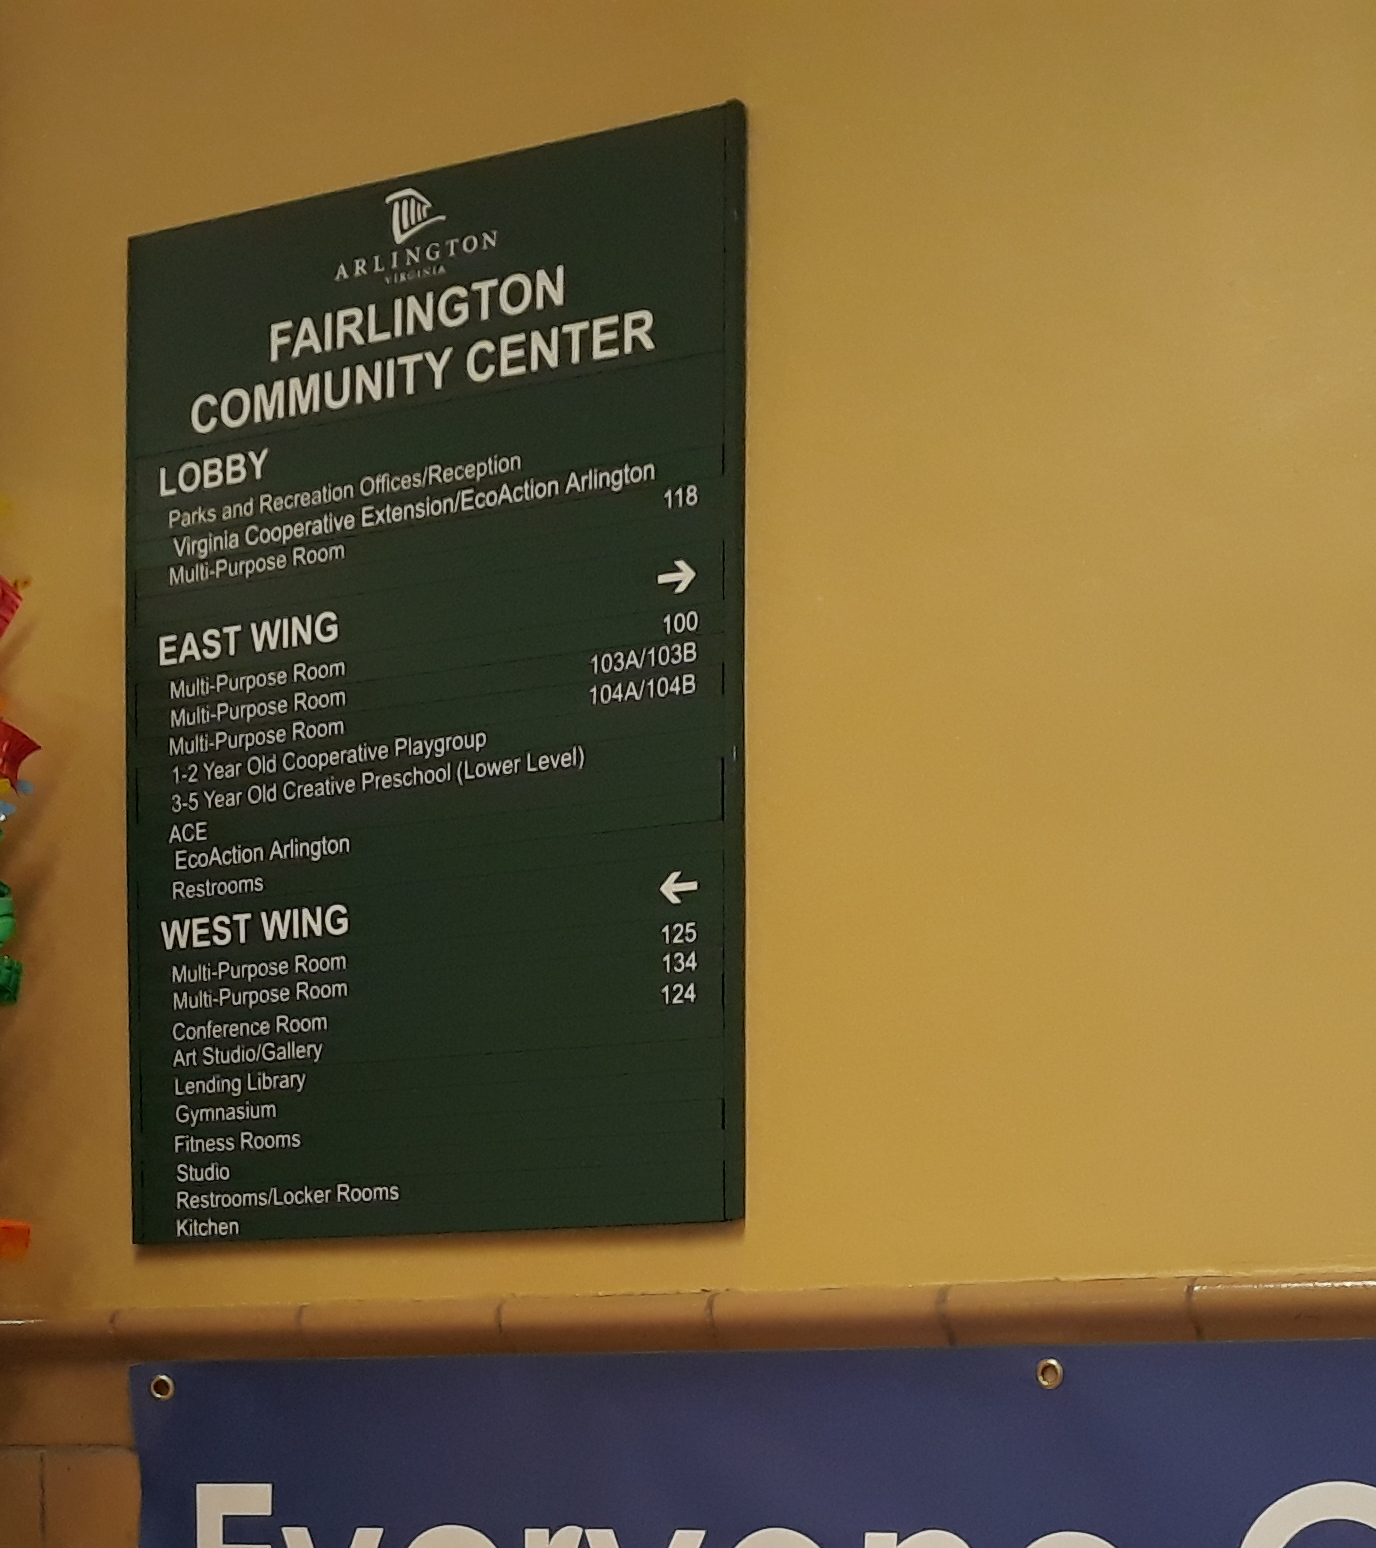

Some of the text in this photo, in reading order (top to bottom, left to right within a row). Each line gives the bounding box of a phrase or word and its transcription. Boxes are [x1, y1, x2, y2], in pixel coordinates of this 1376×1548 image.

[334, 230, 498, 281] ARLINGTON
[385, 265, 446, 284] VIRGINIA
[269, 265, 565, 362] FAIRLINGTON
[191, 309, 655, 434] COMMUNITY CENTER
[159, 448, 269, 497] LOBBY
[168, 454, 522, 528] Parks and Recreation Offices/Reception
[664, 485, 698, 510] 118
[174, 463, 655, 559] Virginia Cooperative Extension/EcoAction Arlington
[169, 543, 345, 586] Multi-Purpose Room
[663, 611, 698, 635] 100
[159, 611, 339, 666] EAST WING
[590, 641, 697, 674] 103A/103B
[170, 661, 345, 699] Multi-Purpose Room
[589, 674, 696, 705] 104A/104B
[170, 690, 346, 728] Multi-Purpose Room
[169, 719, 344, 756] Multi-Purpose Room
[173, 729, 487, 784] 1-2 Year Old Cooperative Playgroup
[172, 746, 586, 813] 3-5 Year Old Creative Preschool (Lower Level)
[169, 822, 208, 844] ACE
[175, 836, 350, 870] EcoAction Arlington
[173, 876, 264, 900] Restrooms
[161, 904, 349, 950] WEST WING
[662, 923, 697, 945] 125
[172, 954, 346, 983] Multi-Purpose Room
[663, 952, 697, 973] 134
[173, 980, 348, 1010] Multi-Purpose Room
[662, 983, 696, 1005] 124
[173, 1015, 327, 1041] Conference Room
[173, 1041, 322, 1067] Art Studio/Gallery
[175, 1071, 306, 1096] Lending Library
[175, 1101, 277, 1126] Gymnasium
[175, 1131, 301, 1153] Fitness Rooms
[176, 1163, 230, 1182] Studio
[176, 1183, 400, 1209] Restrooms/Locker Rooms
[176, 1218, 239, 1237] Kitchen
